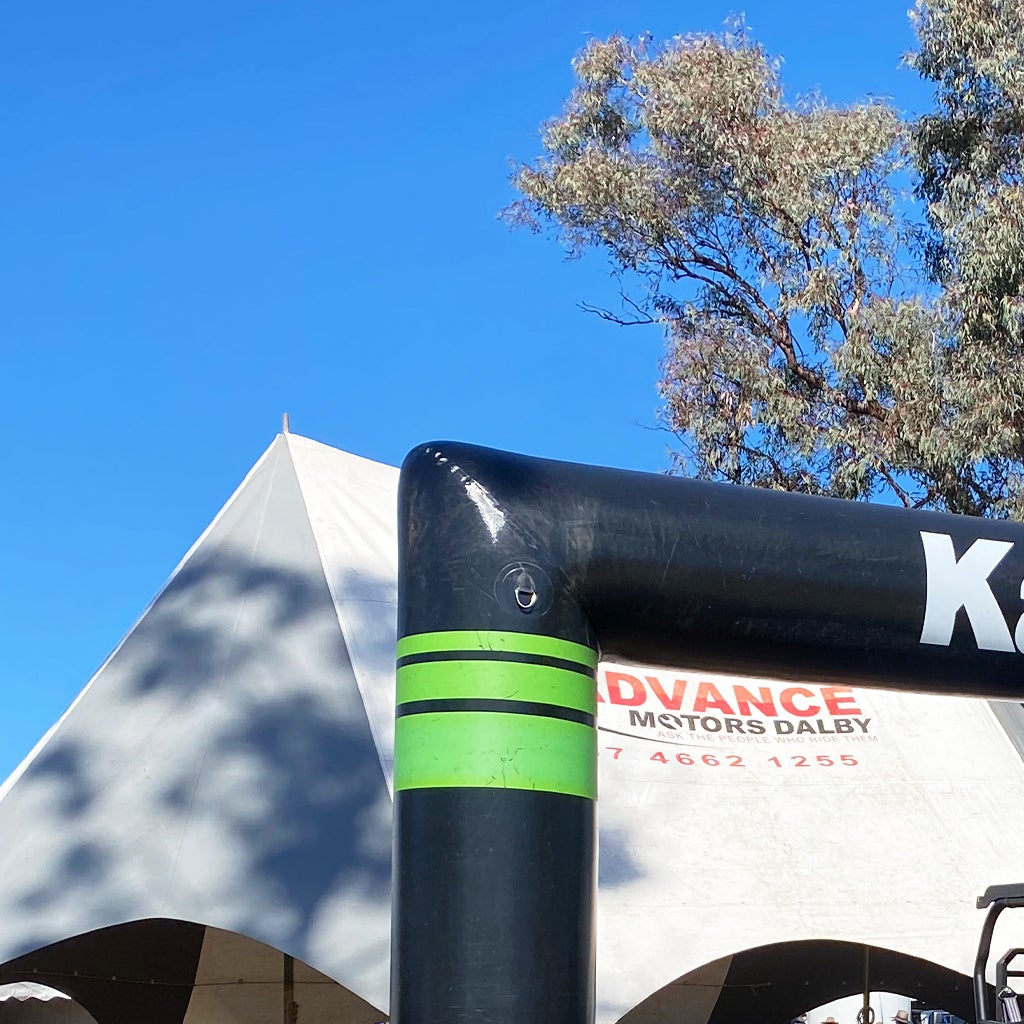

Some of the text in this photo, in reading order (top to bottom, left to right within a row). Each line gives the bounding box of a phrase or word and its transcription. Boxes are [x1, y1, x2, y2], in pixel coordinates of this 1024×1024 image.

[629, 710, 872, 735] MOTORS DALBY
[658, 731, 685, 740] ASK
[689, 733, 715, 742] THE
[718, 735, 771, 744] PEOPLE
[773, 736, 805, 744] WHO
[650, 751, 746, 767] 4662
[768, 755, 859, 767] 1255
